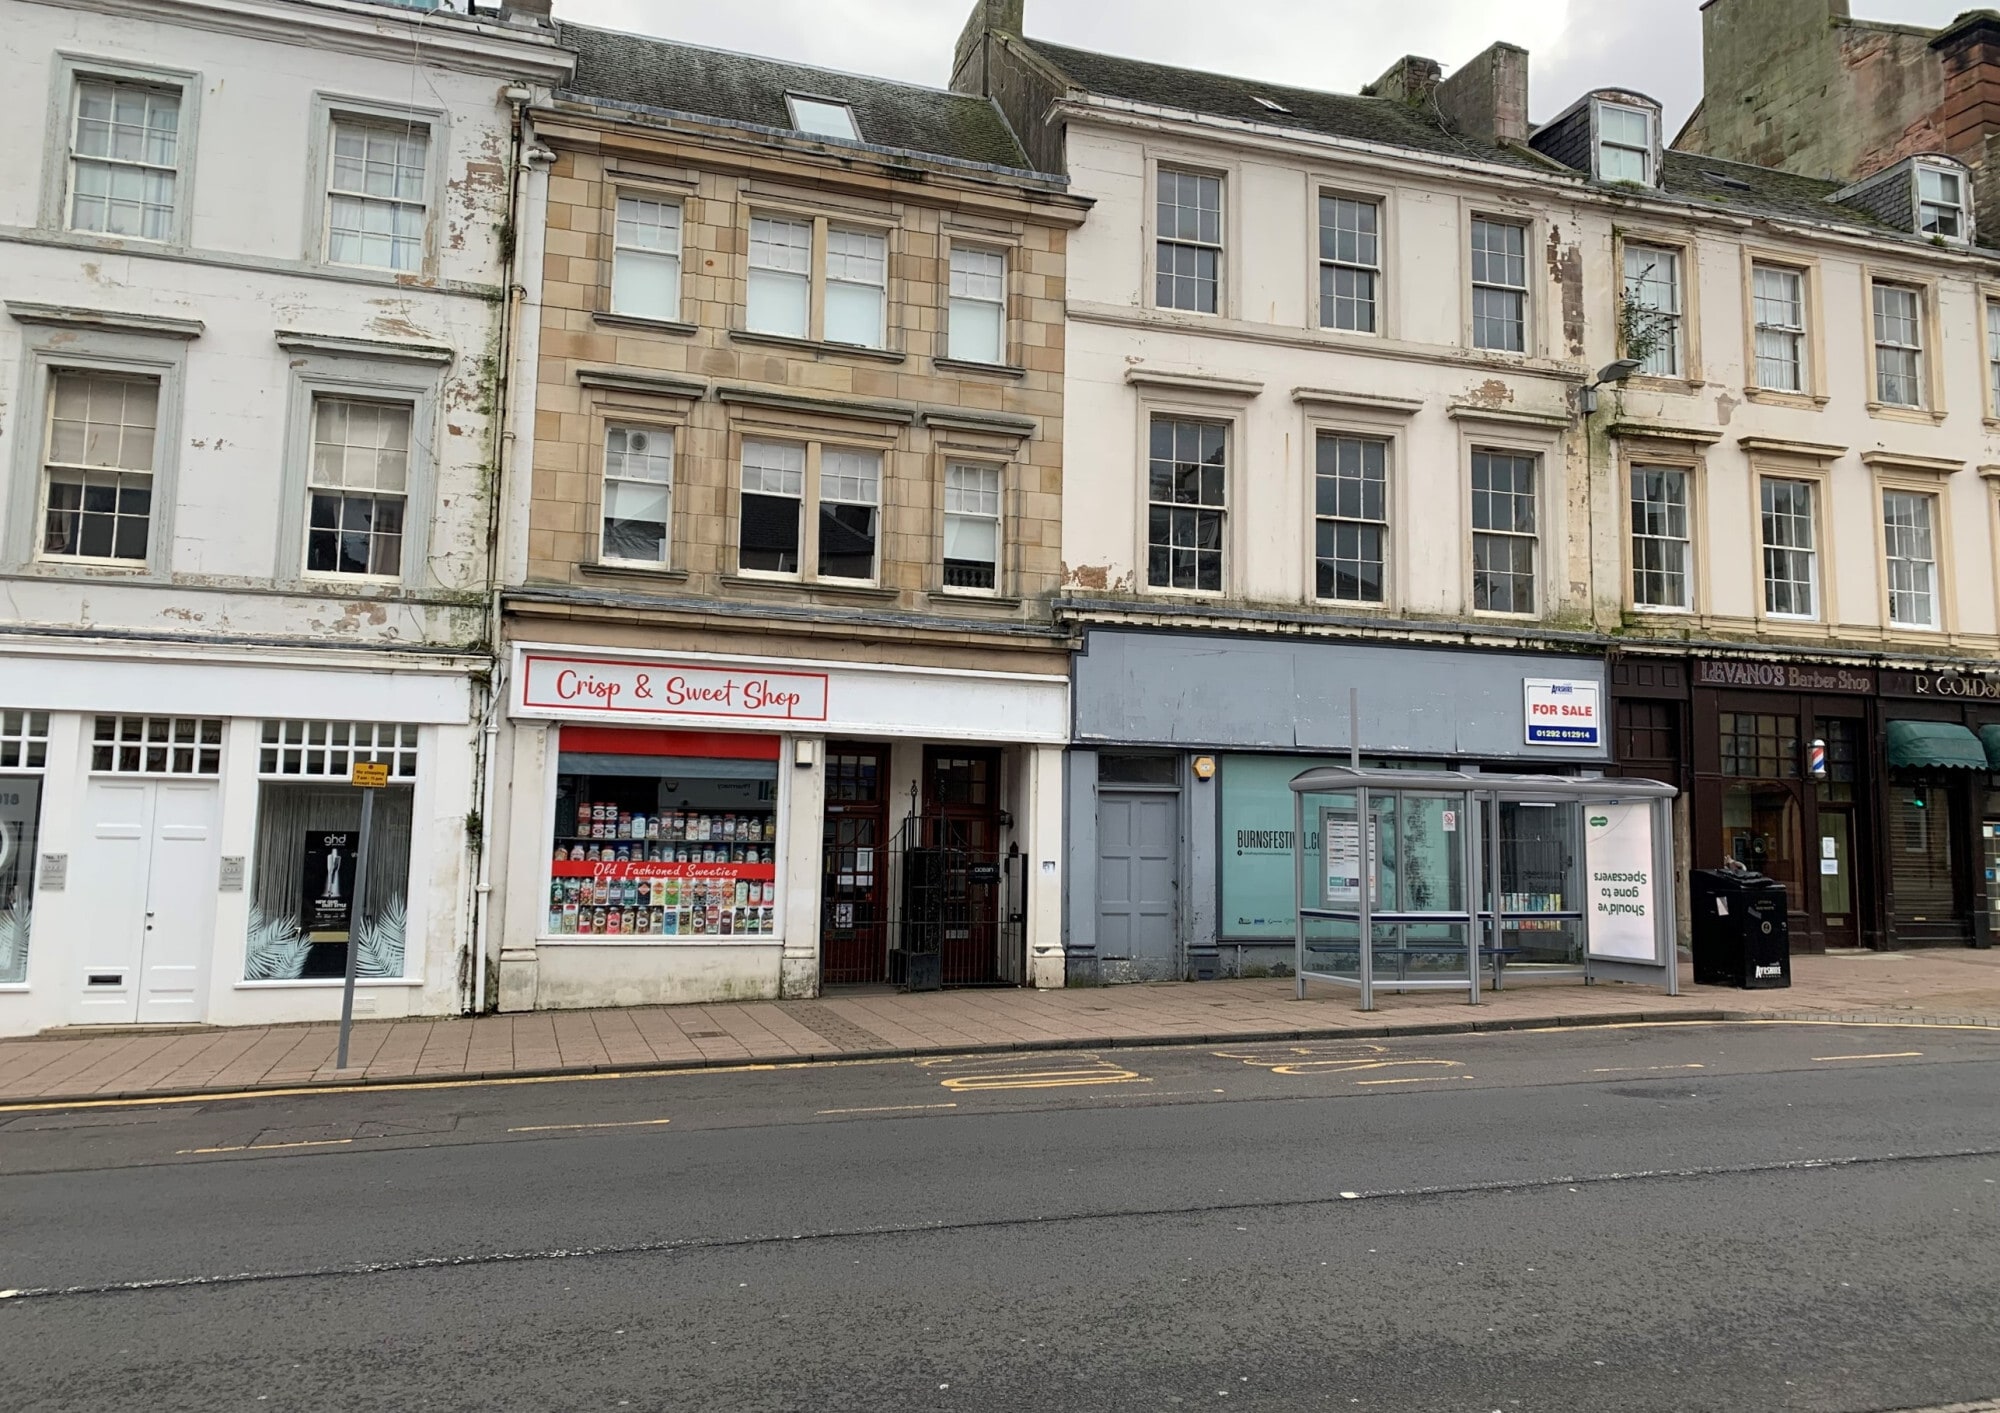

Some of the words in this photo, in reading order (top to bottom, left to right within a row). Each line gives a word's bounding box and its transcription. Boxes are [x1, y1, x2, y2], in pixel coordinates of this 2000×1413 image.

[1700, 661, 1785, 686] LEVANO'S
[1788, 667, 1836, 689] Barber
[1838, 670, 1871, 692] Shop
[556, 670, 621, 708] Crisp
[634, 673, 653, 698] &
[666, 676, 740, 706] Sweet
[743, 680, 800, 717] Shop
[1532, 704, 1558, 715] FOR
[1561, 705, 1593, 716] SALE
[1536, 730, 1560, 738] 01292
[324, 833, 347, 847] ghd
[1237, 829, 1320, 850] BURNSFESTIL.C
[593, 862, 617, 875] Old
[624, 862, 681, 876] Fashioned
[686, 864, 739, 877] Sweeties
[1593, 871, 1647, 885] Specsavers
[1601, 887, 1611, 898] to
[1614, 886, 1639, 898] gone
[1597, 903, 1645, 916] Should've
